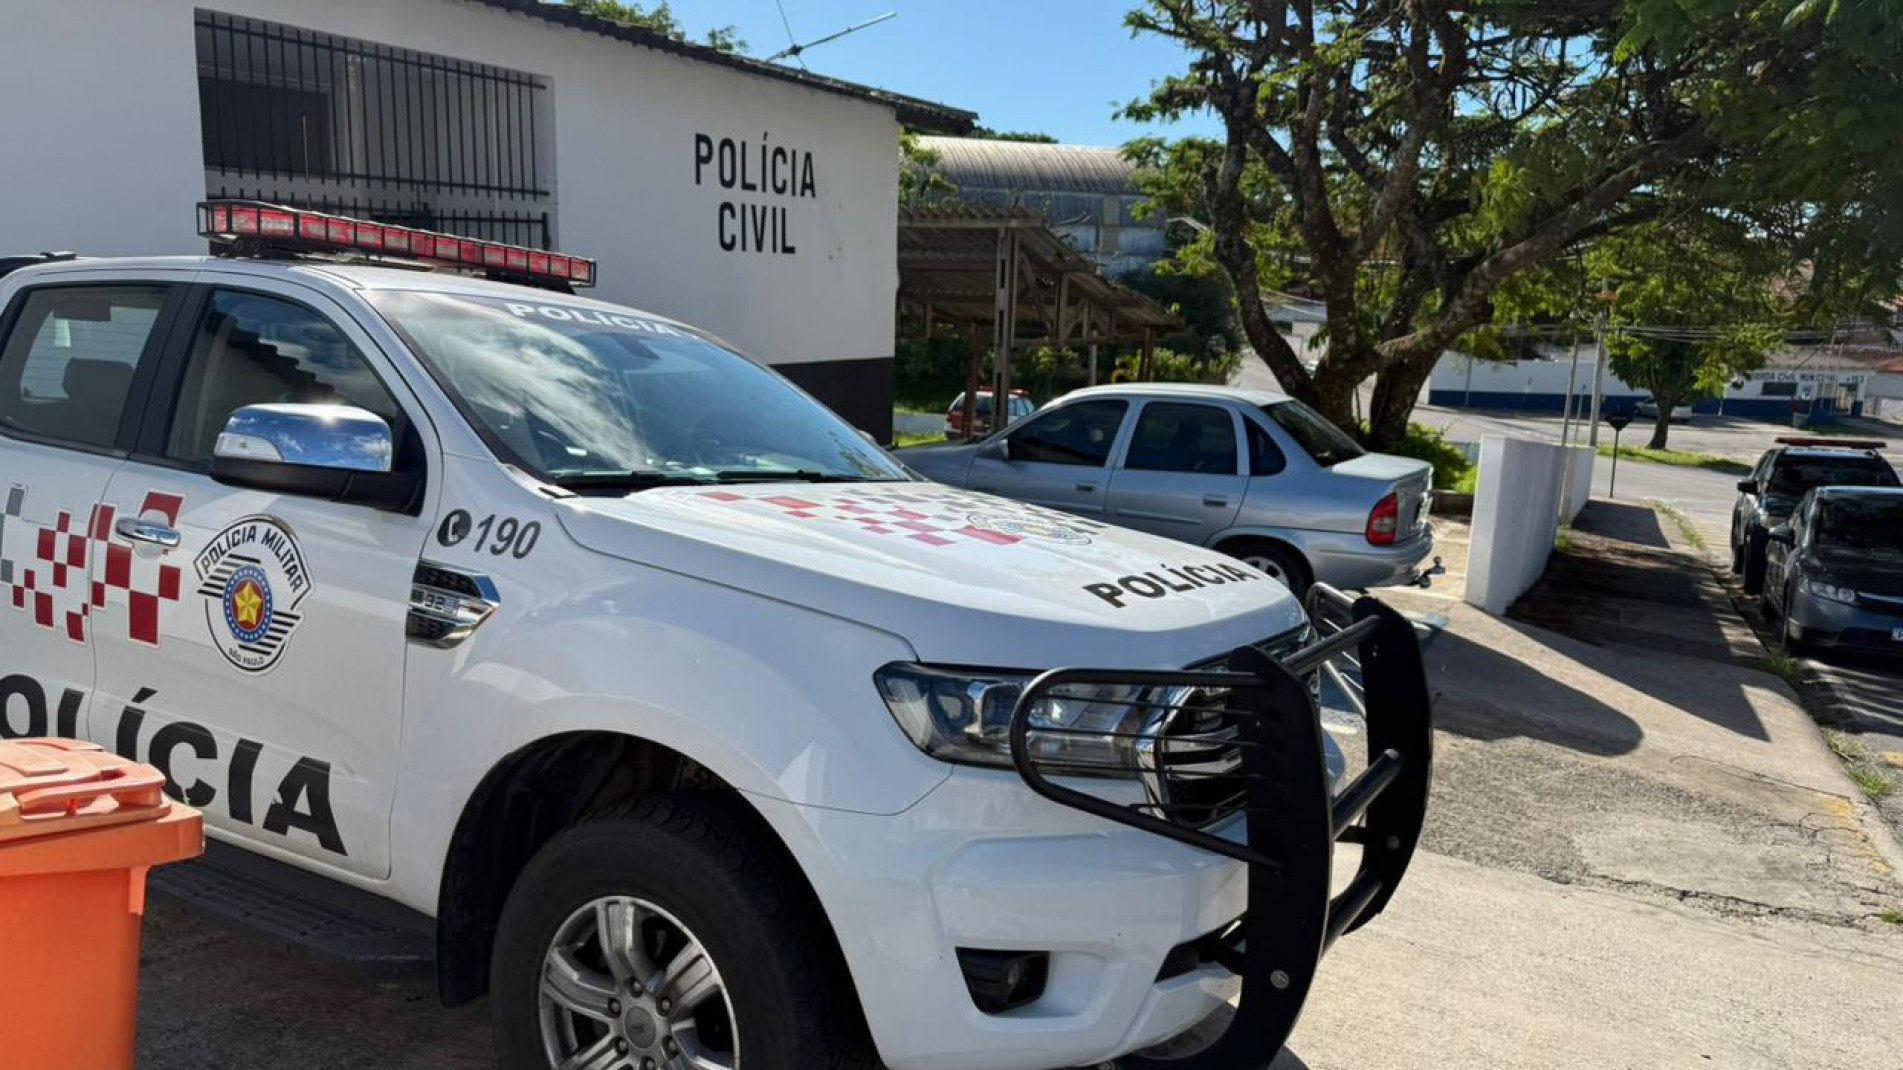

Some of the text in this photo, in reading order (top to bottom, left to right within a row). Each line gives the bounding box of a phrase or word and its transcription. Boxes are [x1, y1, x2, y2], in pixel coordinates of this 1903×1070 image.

[695, 131, 817, 199] POLÍCIA
[719, 201, 796, 254] CIVIL
[261, 528, 304, 593] MILITAR
[474, 513, 541, 560] 190
[1082, 563, 1259, 608] POLÍCIA
